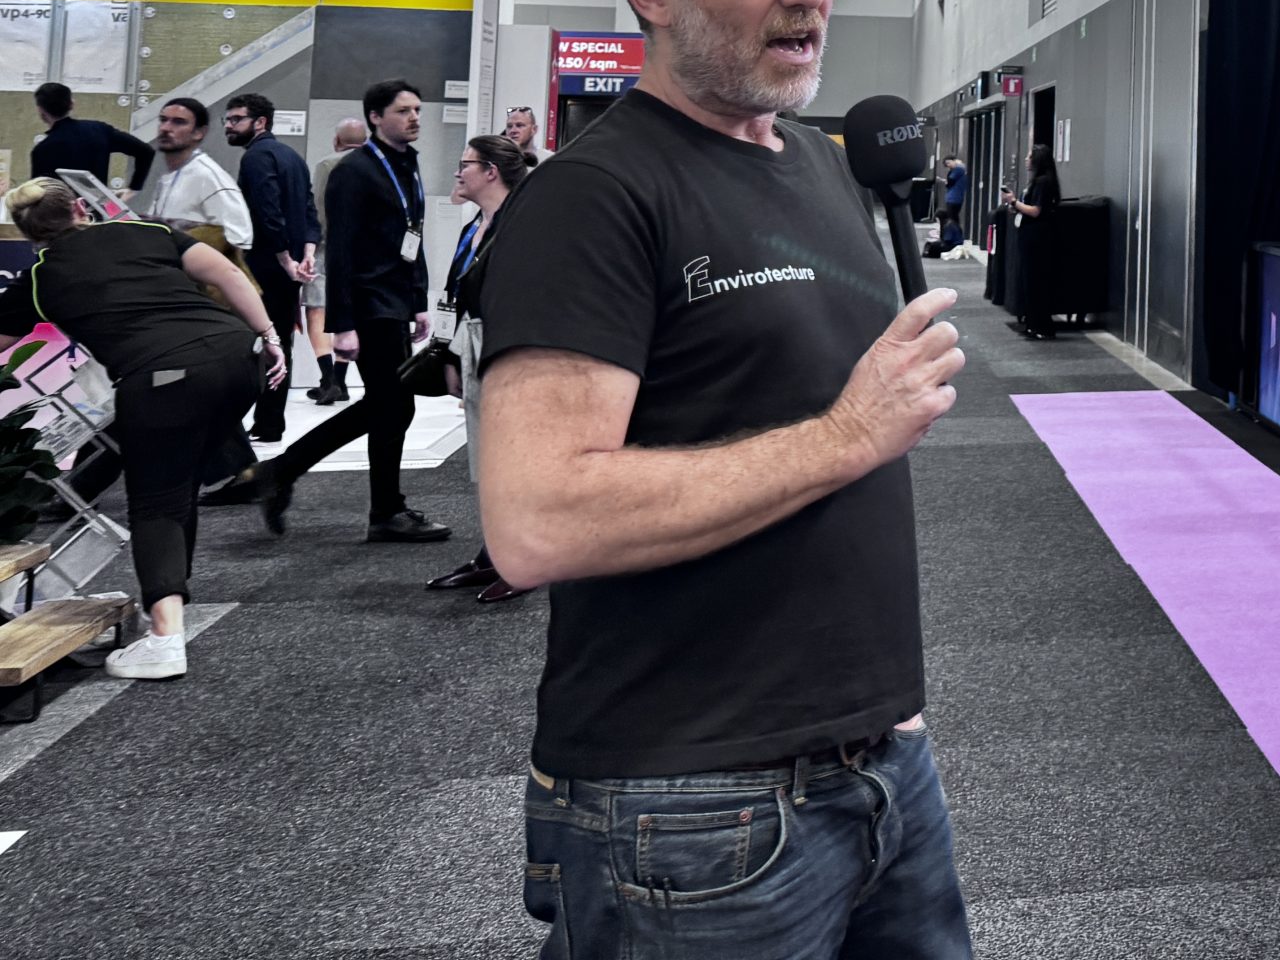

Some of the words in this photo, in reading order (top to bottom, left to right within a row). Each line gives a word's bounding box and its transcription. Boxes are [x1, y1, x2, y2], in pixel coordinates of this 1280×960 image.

[571, 41, 625, 53] SPECIAL
[584, 77, 625, 92] EXIT
[683, 255, 816, 304] Envirotecture
